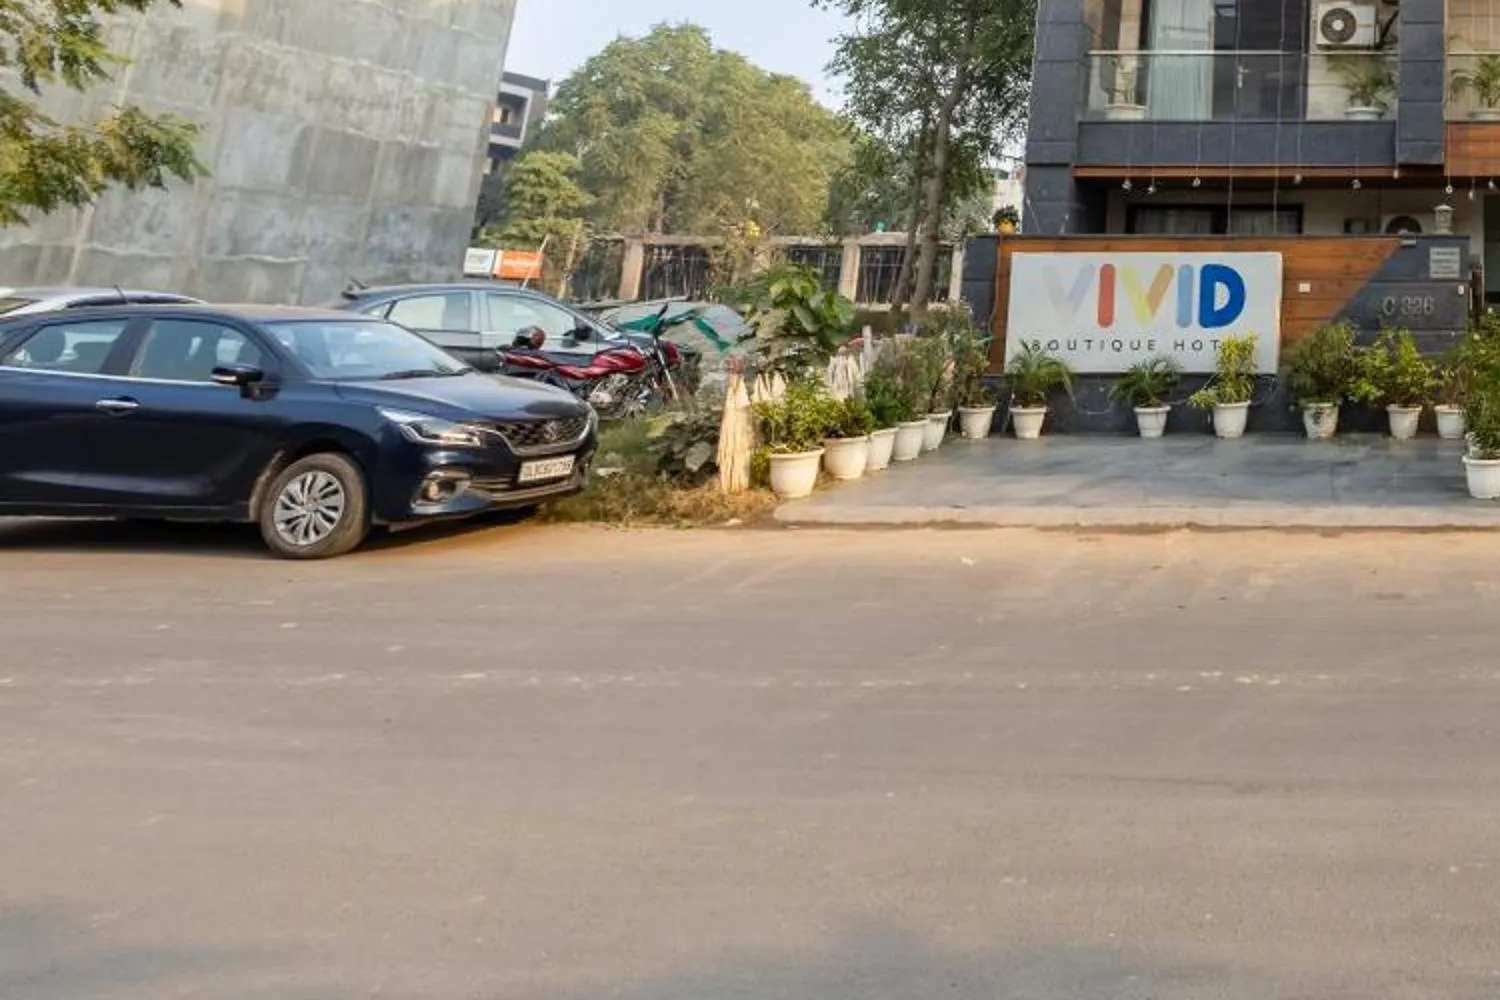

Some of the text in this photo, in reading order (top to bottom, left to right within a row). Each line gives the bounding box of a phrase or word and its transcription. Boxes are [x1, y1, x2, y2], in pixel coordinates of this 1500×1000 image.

[1043, 263, 1246, 328] VIVID
[1382, 296, 1395, 316] C
[1031, 339, 1232, 352] BOUTIQUE HOT
